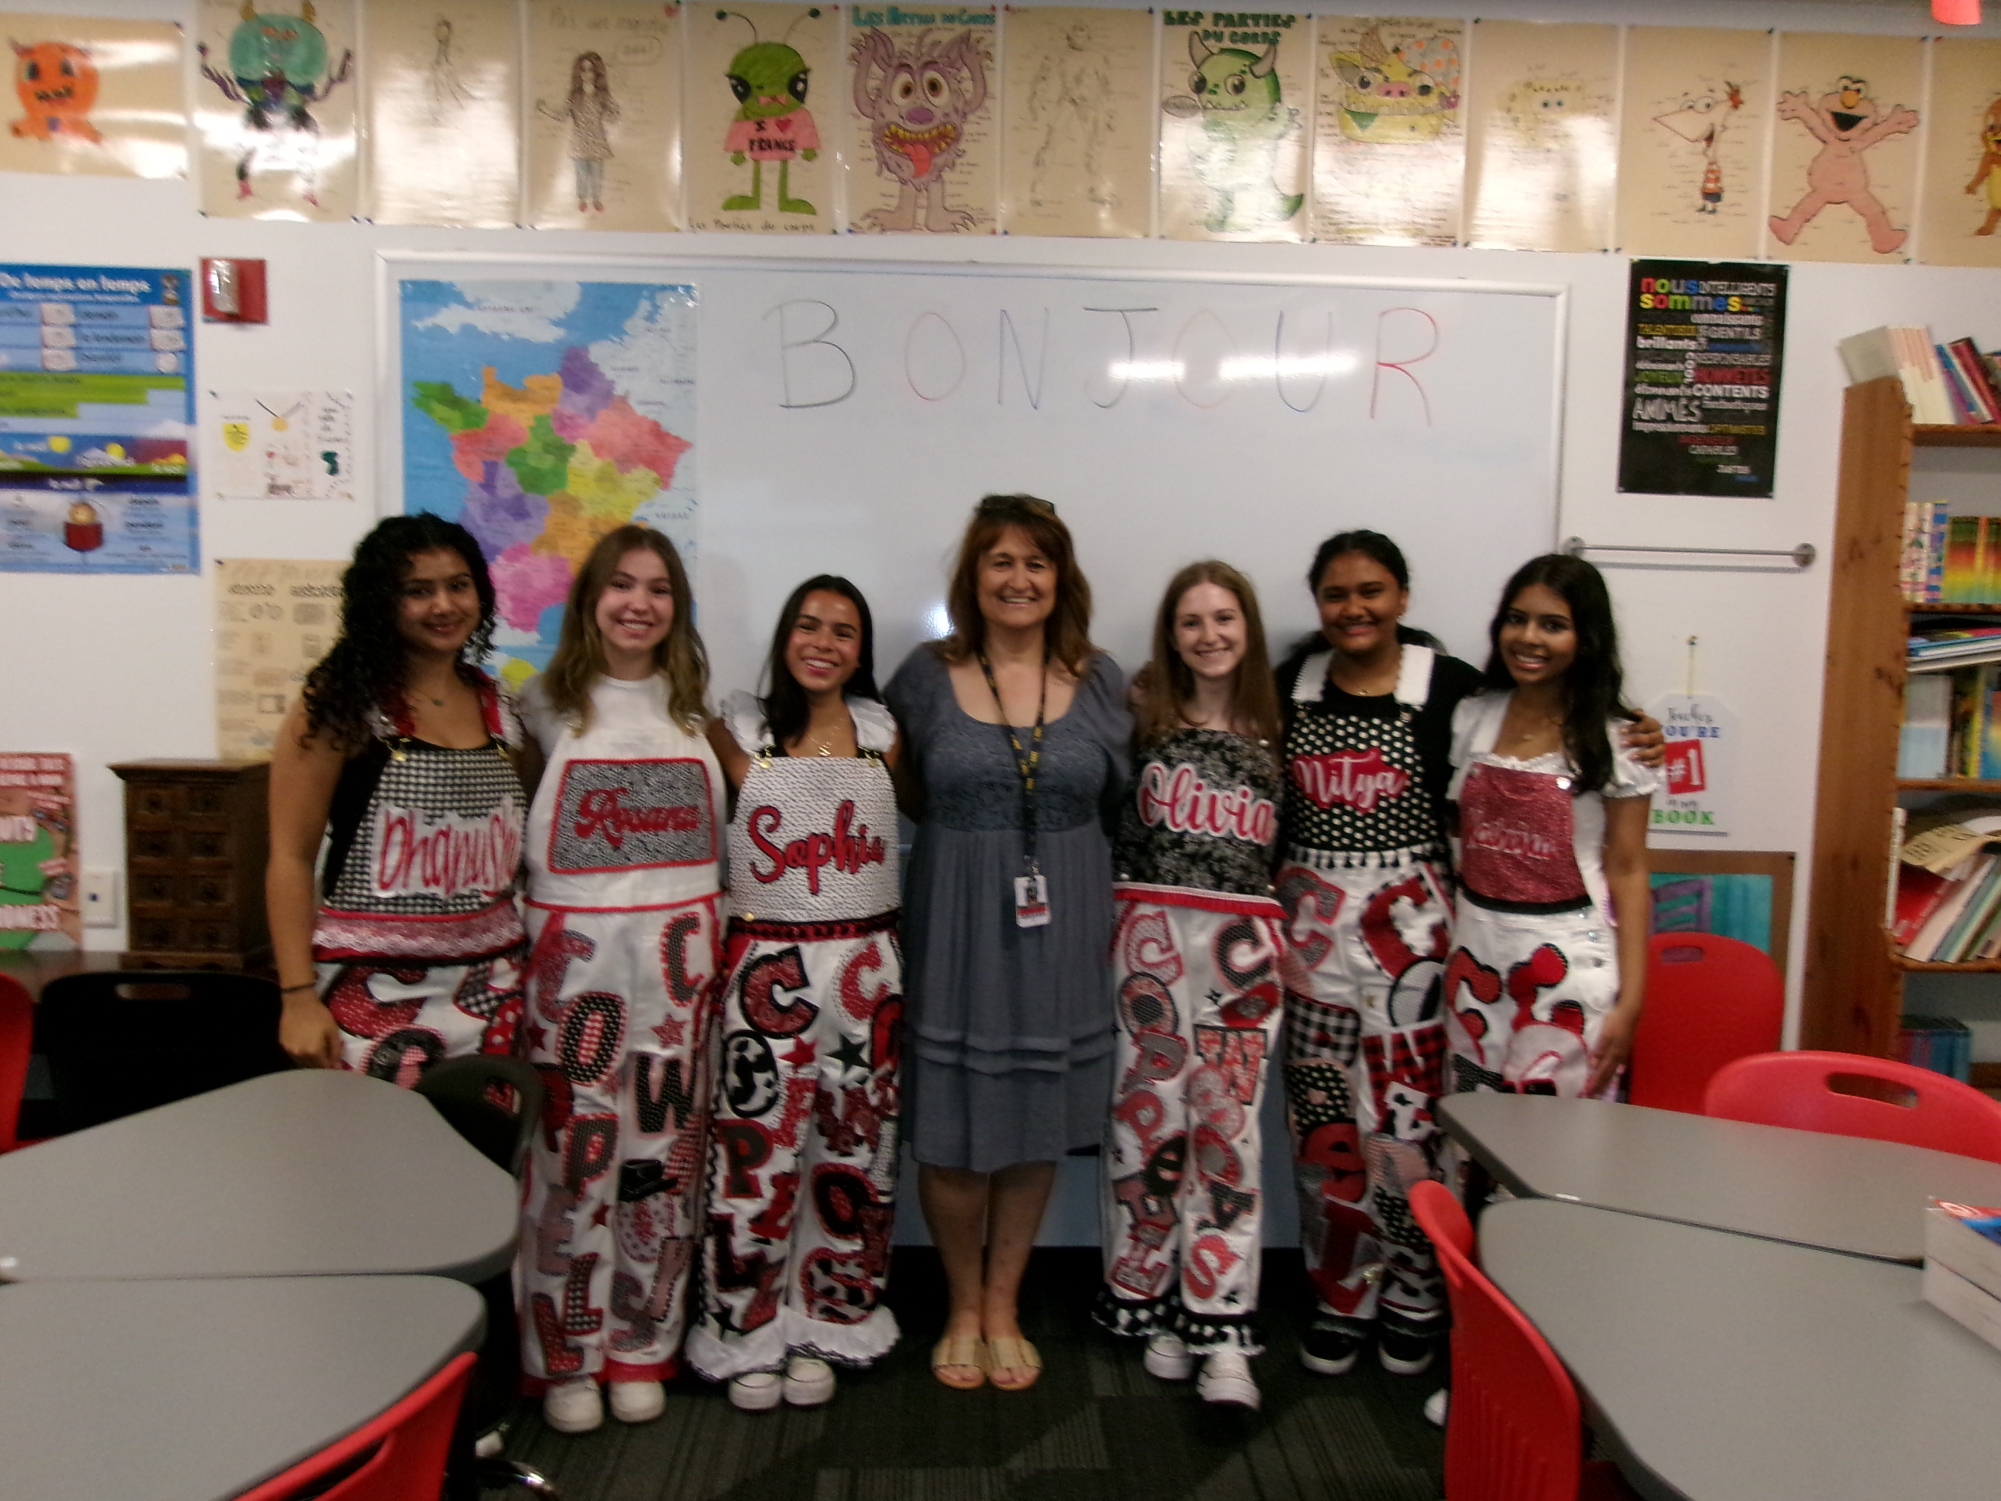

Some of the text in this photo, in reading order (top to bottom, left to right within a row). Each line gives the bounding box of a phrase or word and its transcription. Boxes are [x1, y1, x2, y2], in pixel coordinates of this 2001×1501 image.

[750, 138, 795, 152] FRANCE
[1641, 278, 1699, 295] nous
[763, 299, 1440, 426] BONJOUR
[1693, 384, 1770, 398] CONTENTS
[1661, 725, 1721, 738] OU'RE
[1667, 748, 1702, 786] #1
[1296, 752, 1399, 809] Nitya
[1140, 764, 1276, 845] Olivia
[1652, 808, 1716, 826] BOOK
